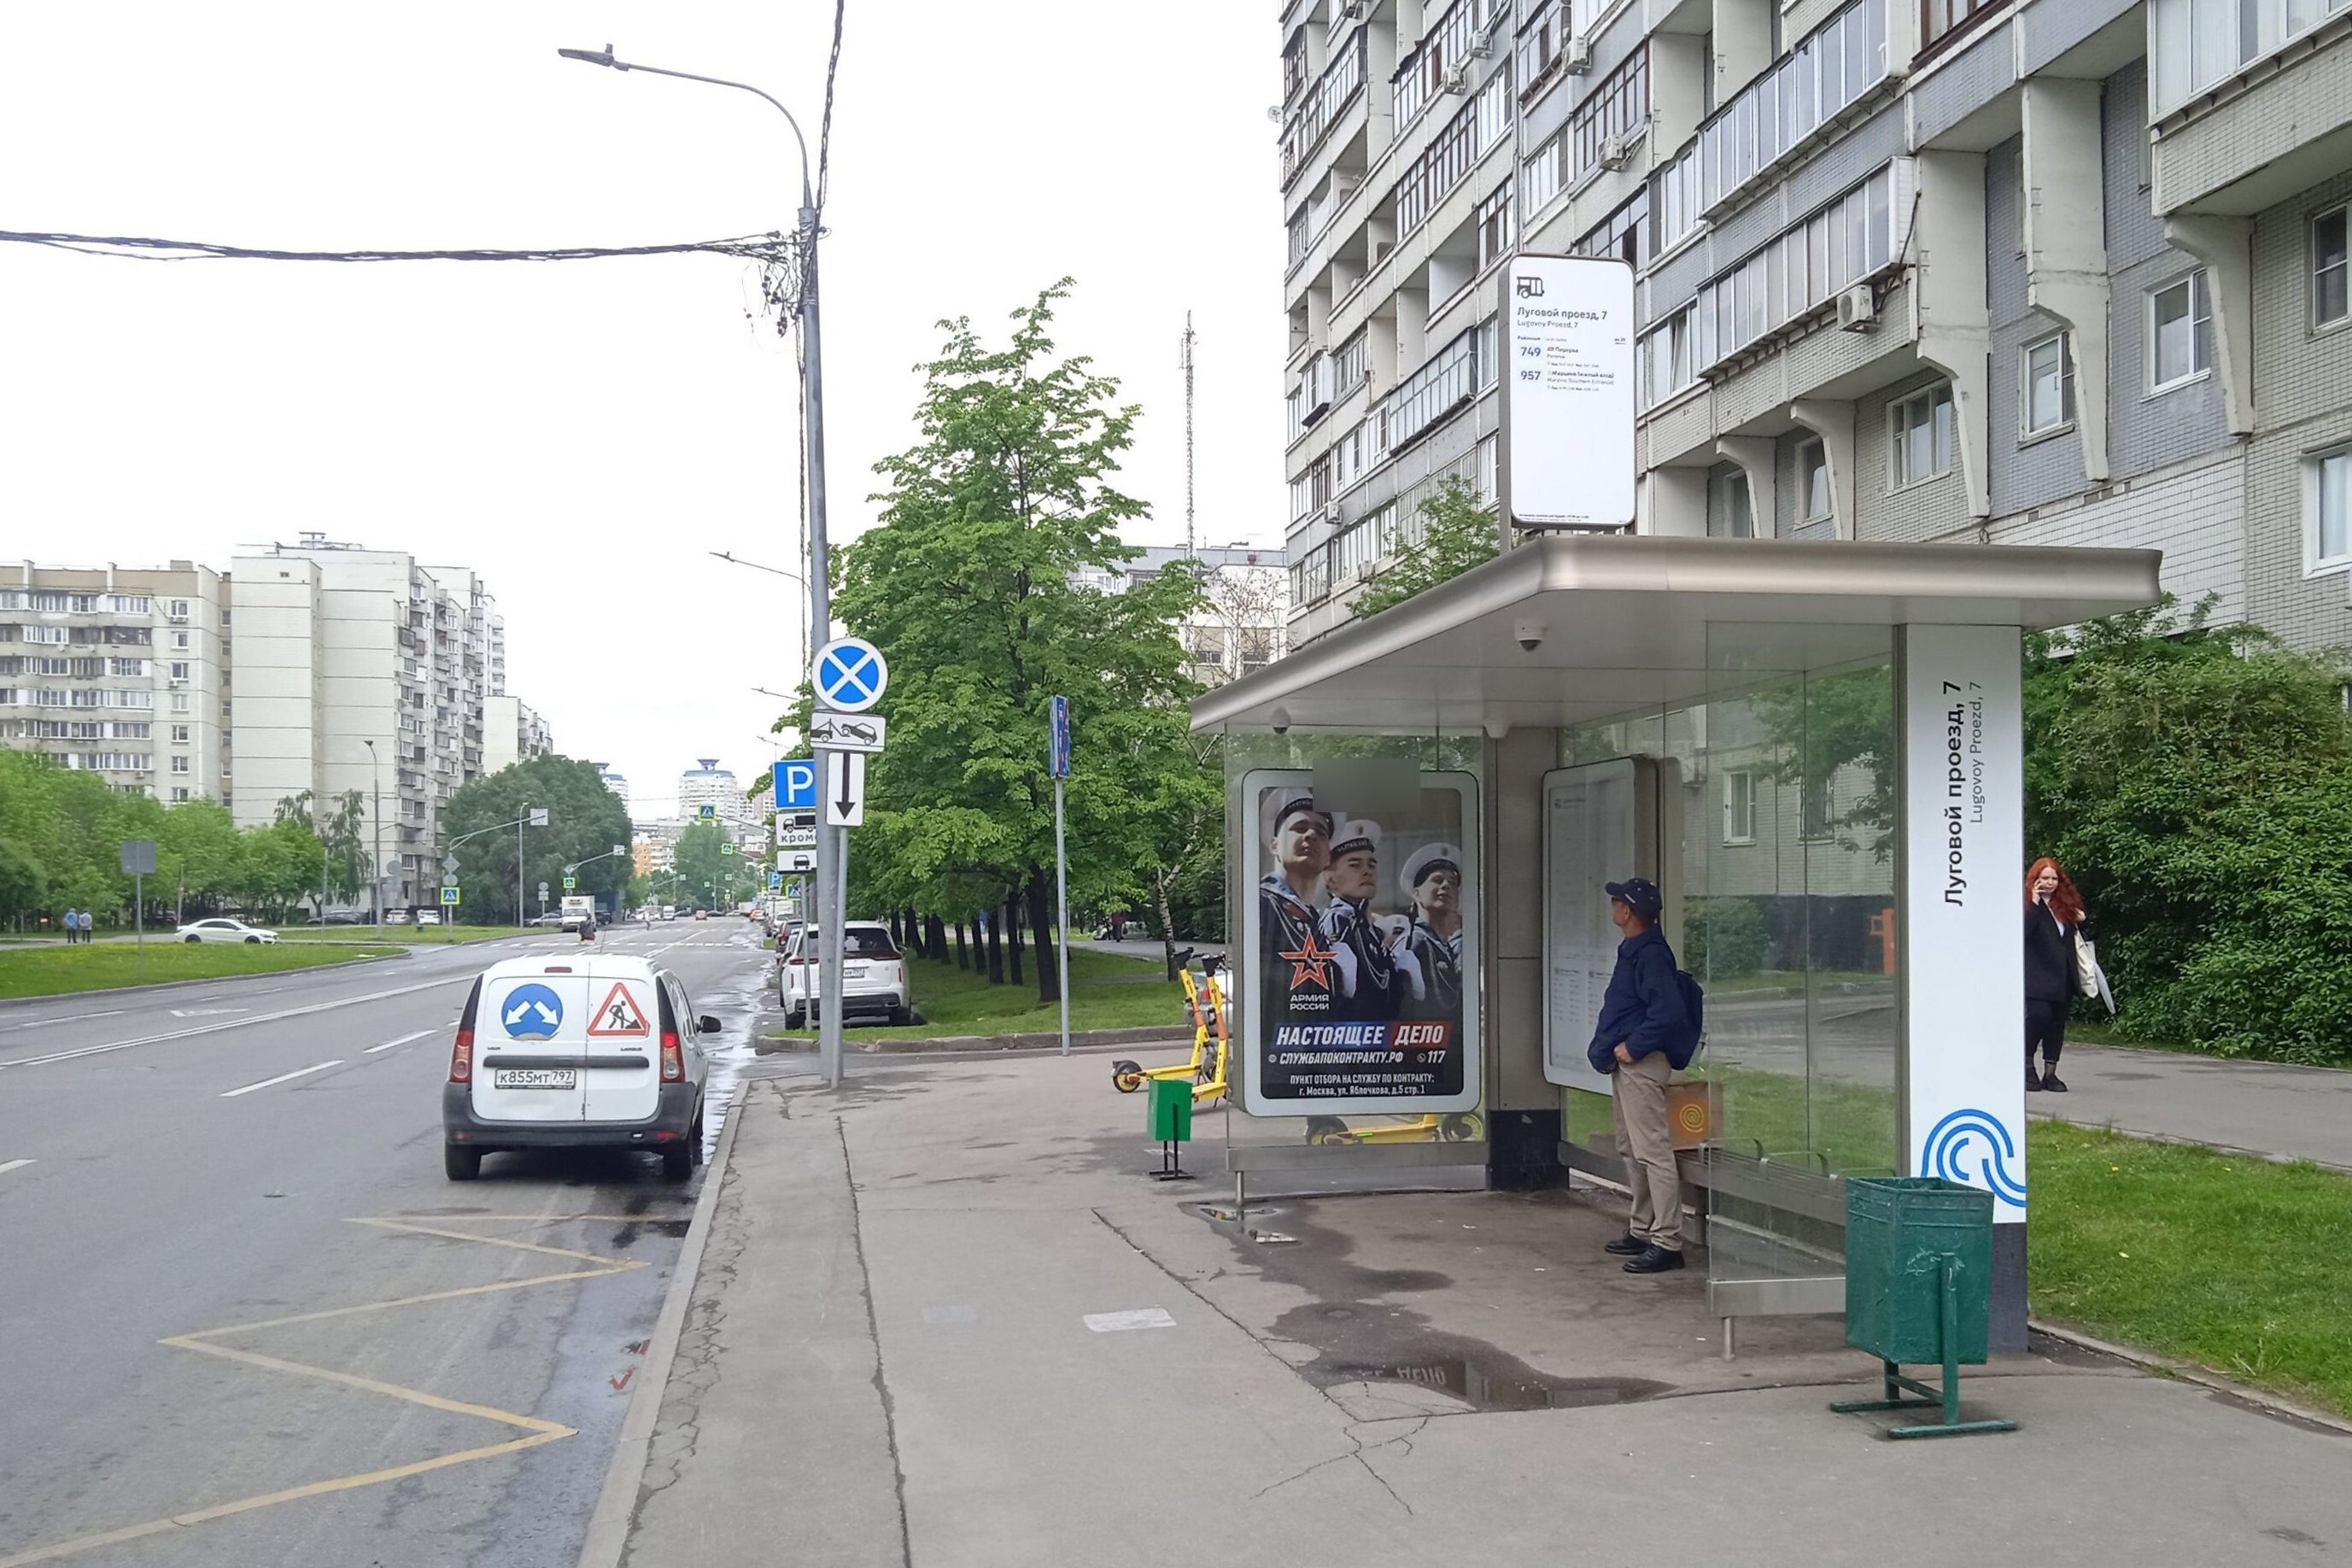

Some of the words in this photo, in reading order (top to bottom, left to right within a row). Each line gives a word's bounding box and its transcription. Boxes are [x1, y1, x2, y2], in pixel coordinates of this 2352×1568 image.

[1517, 307, 1559, 318] Луговой
[1561, 310, 1600, 320] проезд,
[1601, 311, 1608, 319] 7
[1517, 319, 1546, 328] Lugovoy
[1520, 347, 1541, 357] 749
[1520, 371, 1541, 381] 957
[1943, 681, 1962, 694] 7
[1969, 682, 1982, 691] 7
[1969, 696, 1984, 754] Proezd,
[1947, 703, 1966, 798] проезд,
[787, 765, 814, 804] P
[1969, 759, 1986, 824] Lugovoy
[1944, 808, 1967, 907] Луговой
[1290, 994, 1330, 1003] АРМИЯ
[1276, 1026, 1385, 1046] НАСТОЯЩЕЕ
[1394, 1025, 1444, 1046] ДЕЛО
[1279, 1051, 1404, 1064] СЛУЖБАПОКОНТРАКТУ.РФ
[1427, 1050, 1447, 1063] 117
[553, 1071, 572, 1081] 797
[1290, 1075, 1313, 1085] ПУНКТ
[1313, 1074, 1342, 1084] ОТБОРА
[1342, 1074, 1352, 1084] НА
[1352, 1074, 1382, 1084] СЛУЖБУ
[1382, 1074, 1392, 1083] ПО
[1393, 1073, 1435, 1083] КОНТРАКТУ:
[1306, 1086, 1337, 1097] Москва,
[1337, 1088, 1349, 1097] ул.
[1349, 1085, 1391, 1096] Яблочкова,
[1404, 1086, 1419, 1095] стр.
[1420, 1085, 1425, 1094] 1
